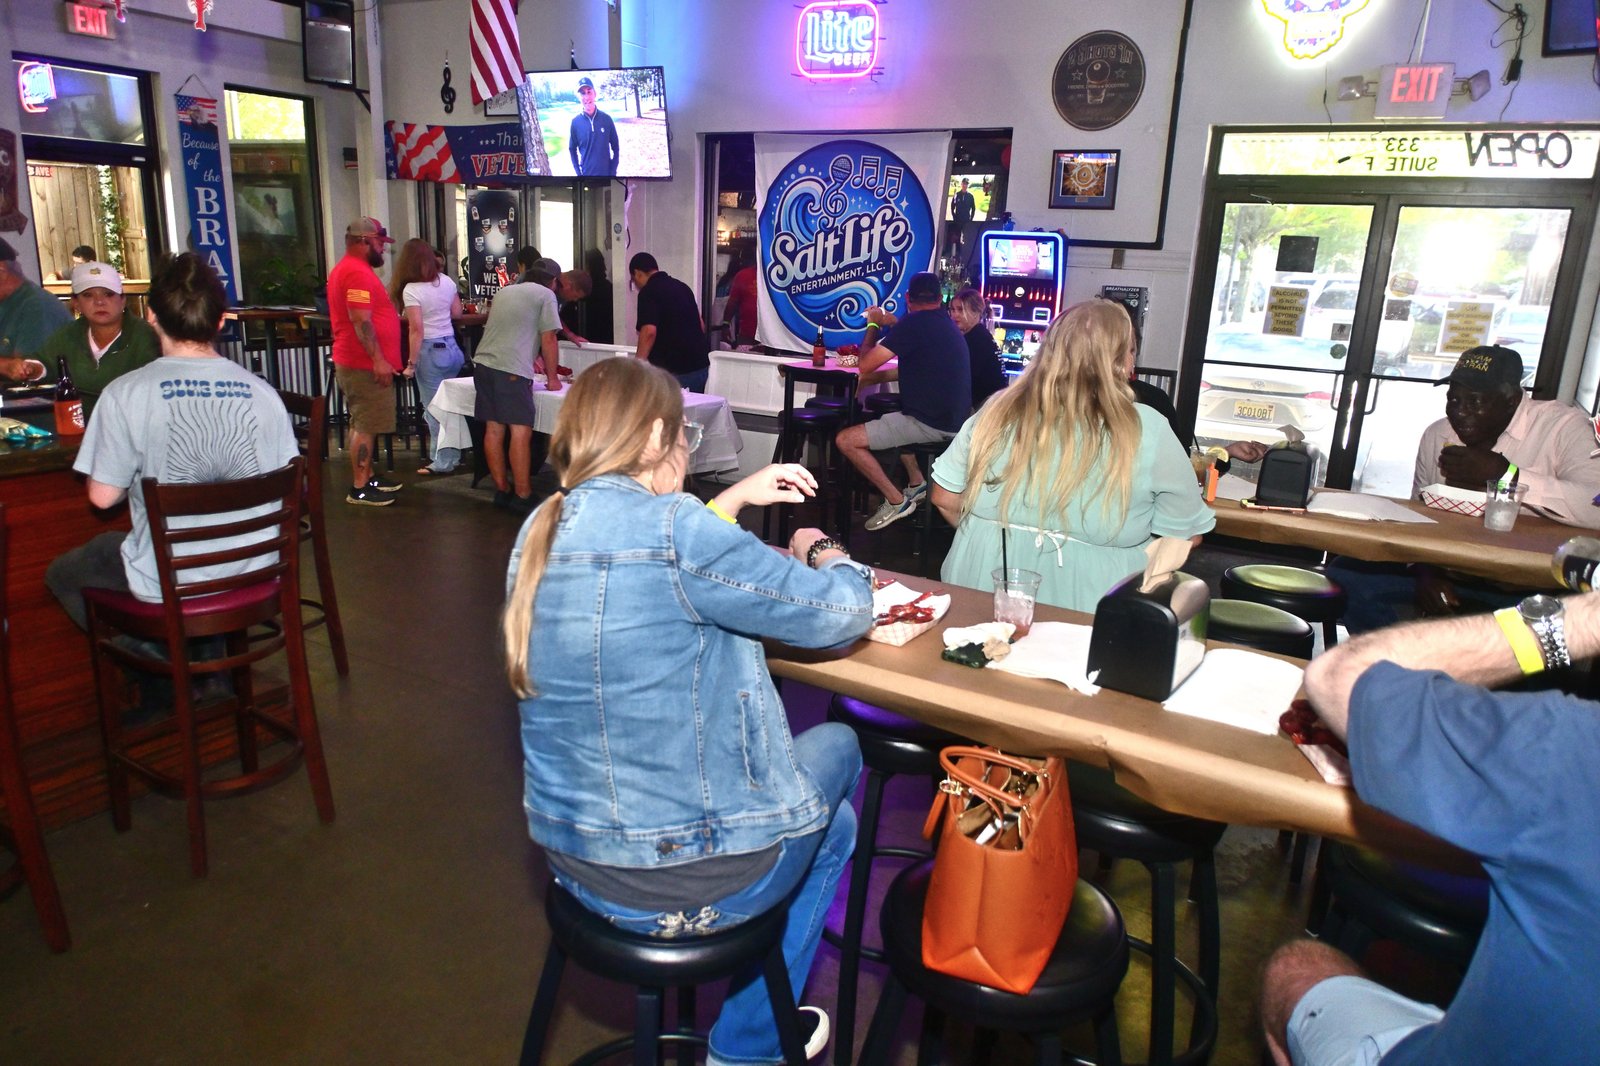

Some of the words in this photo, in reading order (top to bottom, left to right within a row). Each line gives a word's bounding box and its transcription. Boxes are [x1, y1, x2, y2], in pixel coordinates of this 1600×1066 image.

[73, 4, 108, 37] EXIT
[804, 10, 875, 63] Lite
[1390, 67, 1445, 103] EXIT
[182, 132, 220, 151] Because
[187, 152, 201, 171] of
[203, 168, 221, 183] the
[771, 231, 840, 288] Salt
[839, 208, 910, 269] Life
[483, 272, 498, 284] WE
[791, 266, 864, 295] ENTERTAINMENT,
[866, 261, 886, 275] LLC.
[1275, 290, 1303, 298] ALCOHOL
[1270, 304, 1304, 312] PERMITTED
